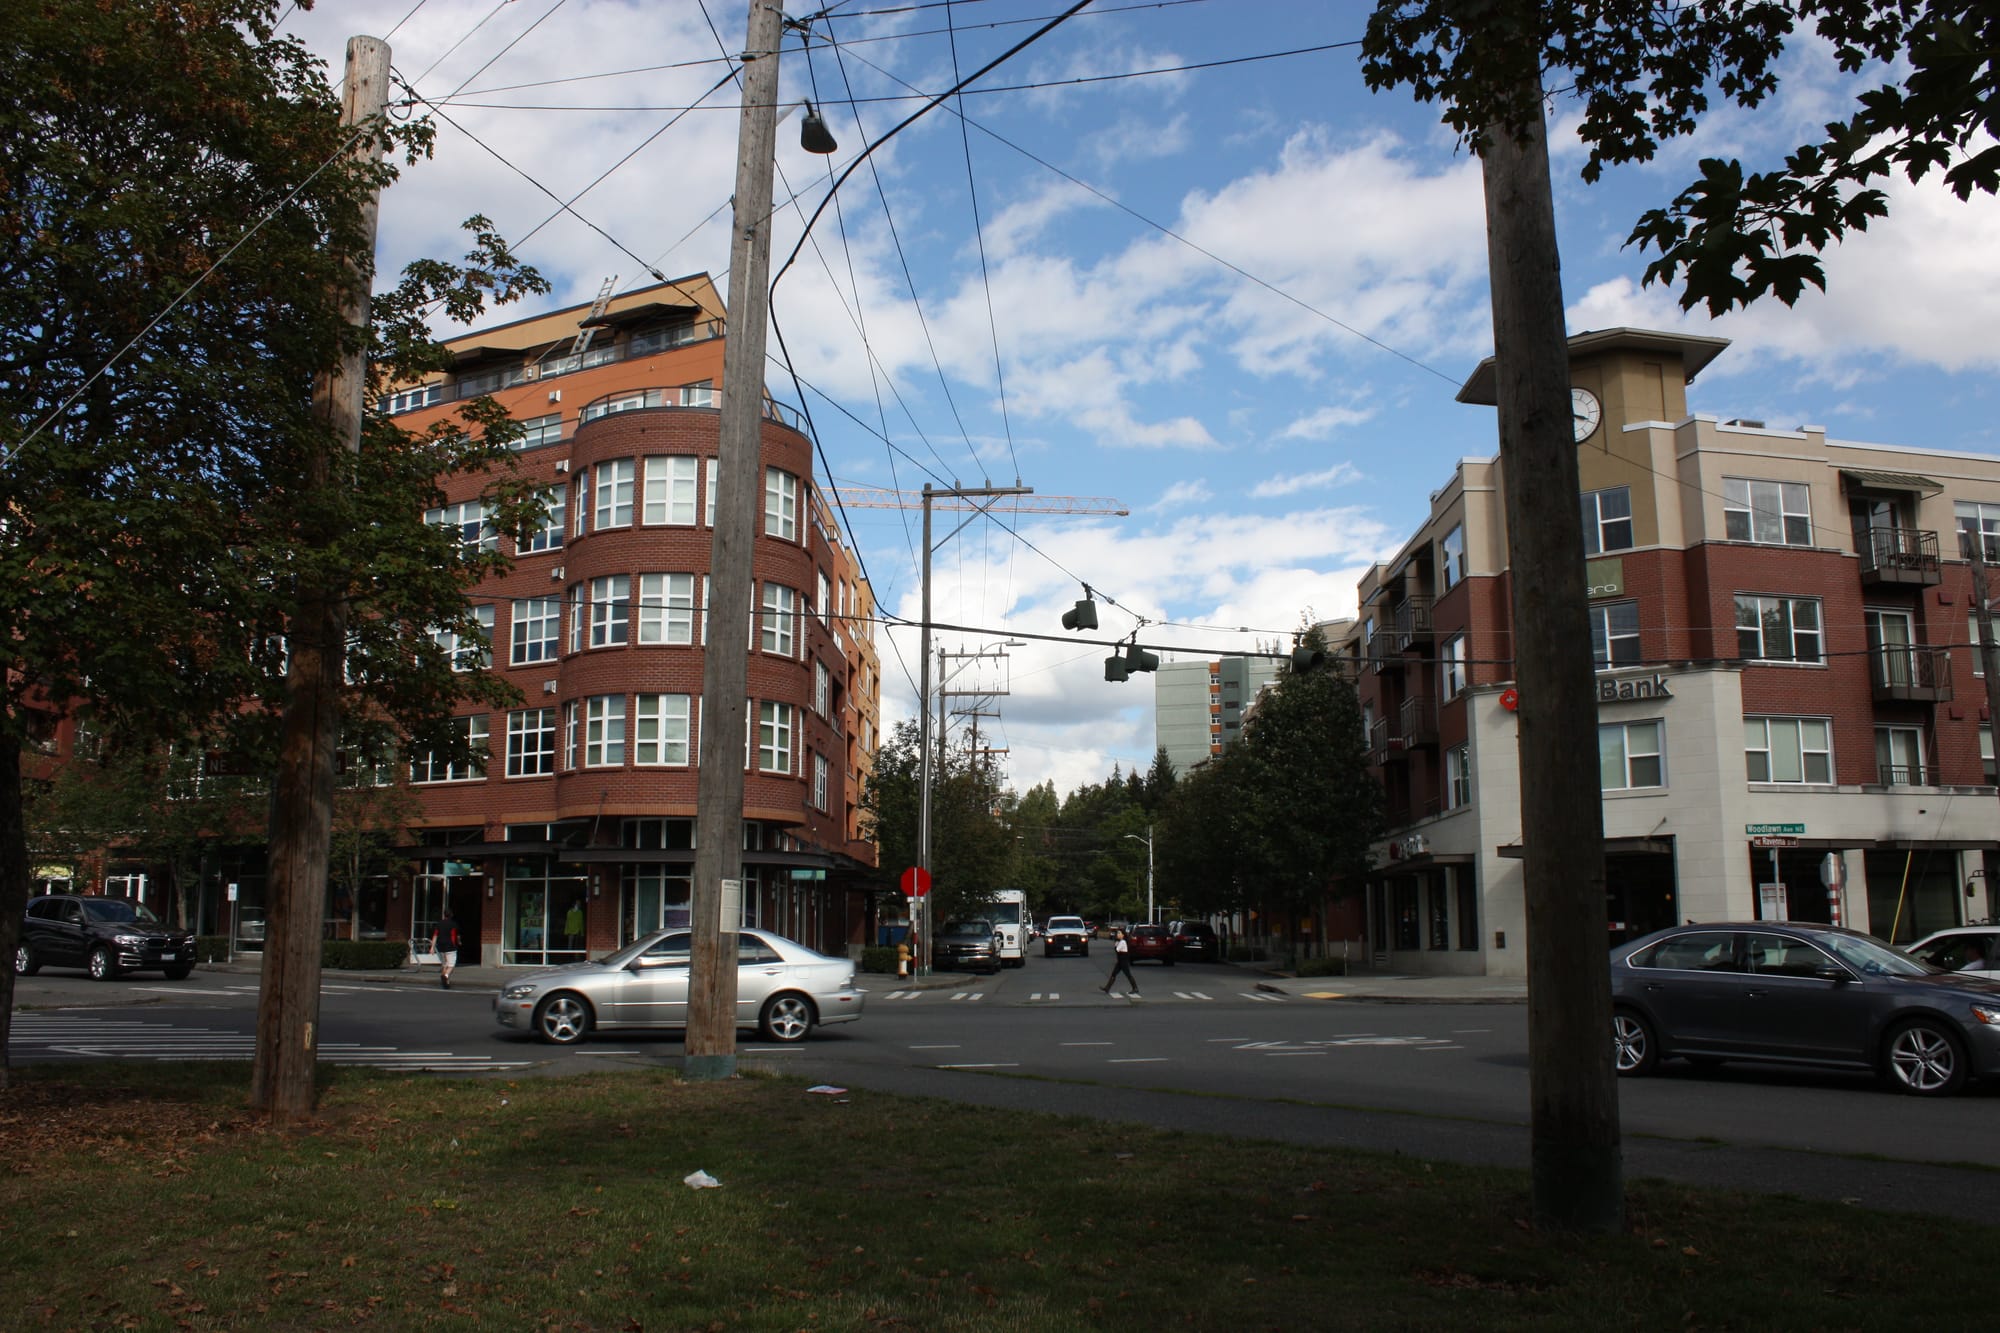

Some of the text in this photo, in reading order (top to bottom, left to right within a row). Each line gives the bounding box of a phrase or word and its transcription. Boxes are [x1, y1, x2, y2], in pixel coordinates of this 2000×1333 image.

[1597, 673, 1670, 700] Bank
[1746, 825, 1781, 833] Woodlawn
[1762, 837, 1786, 846] Ravenna
